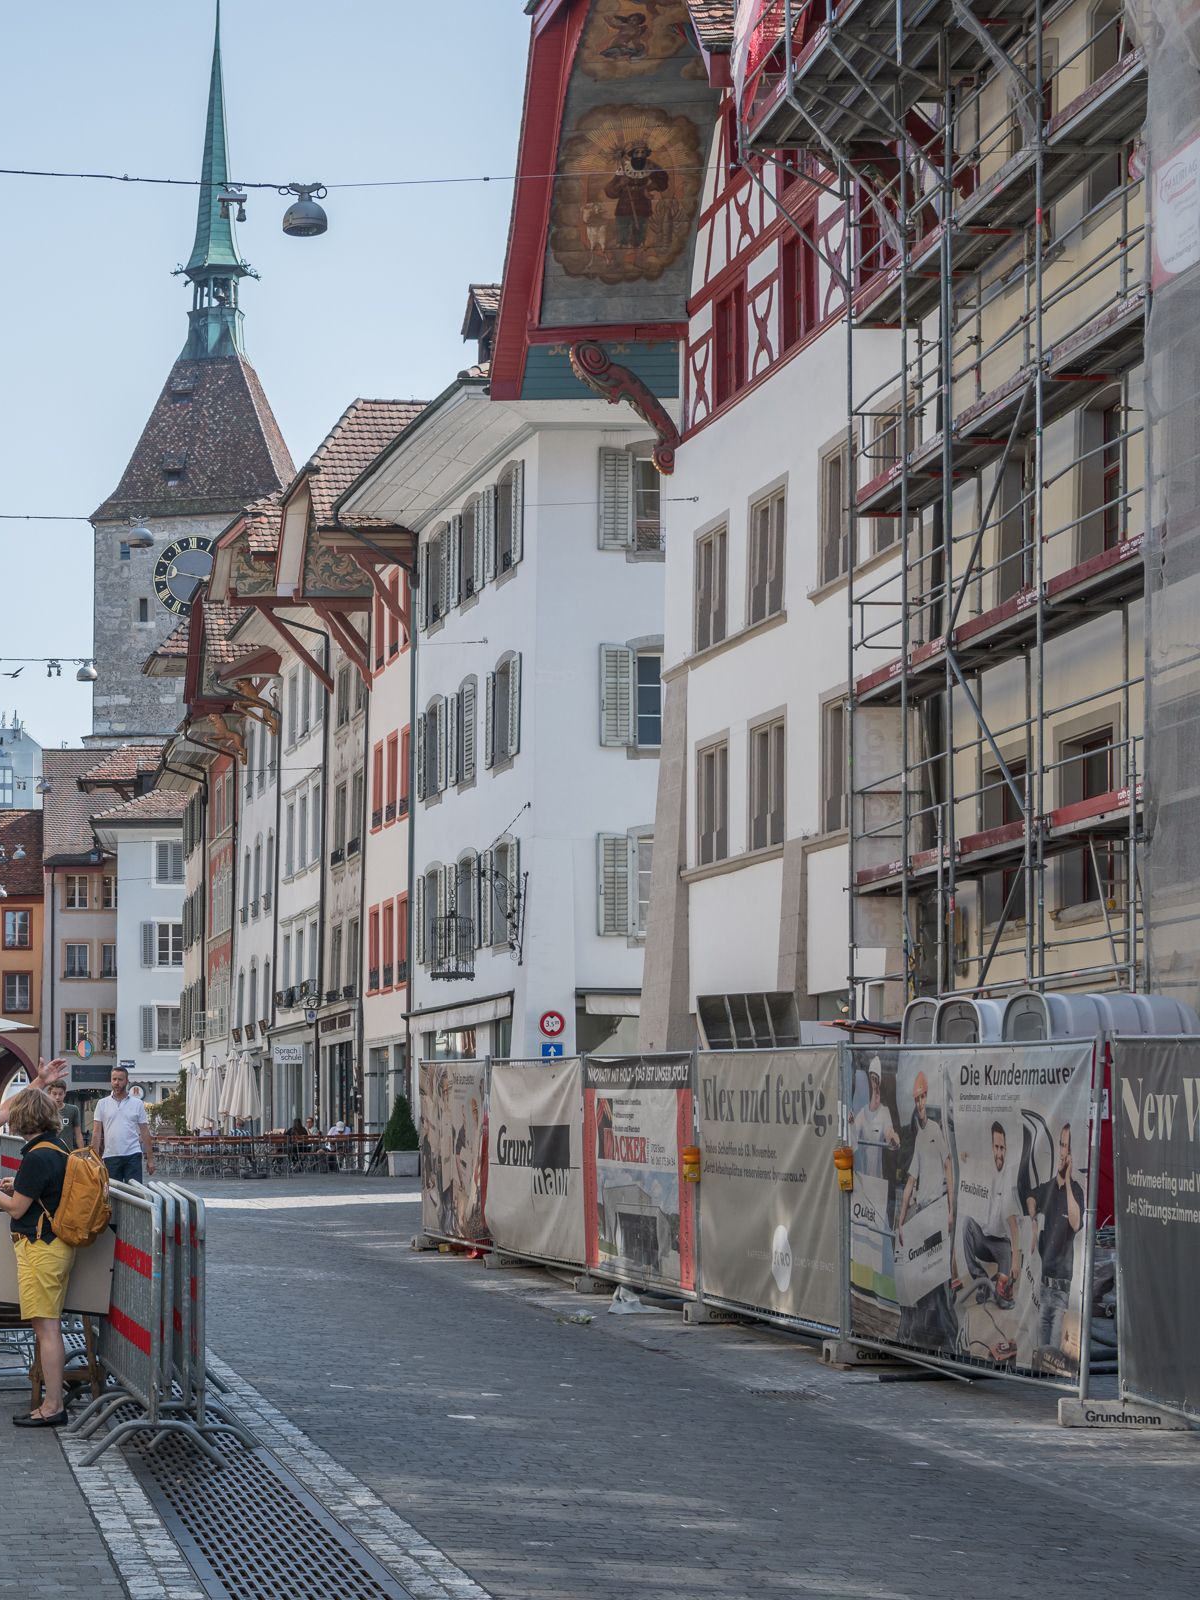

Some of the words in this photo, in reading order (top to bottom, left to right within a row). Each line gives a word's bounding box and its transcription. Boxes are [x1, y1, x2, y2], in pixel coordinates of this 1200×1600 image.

[275, 1046, 298, 1055] Sprach
[655, 1066, 671, 1081] UNSER
[671, 1065, 688, 1081] STOLZ
[960, 1064, 980, 1086] Die
[984, 1063, 1076, 1086] Kundenmaurer
[703, 1075, 735, 1121] Flex
[740, 1074, 770, 1123] und
[776, 1073, 832, 1137] fertig.
[1121, 1077, 1179, 1141] New
[497, 1124, 535, 1168] Grund
[532, 1167, 571, 1196] mann
[1178, 1171, 1195, 1192] und
[1085, 1410, 1161, 1425] Grundmann
